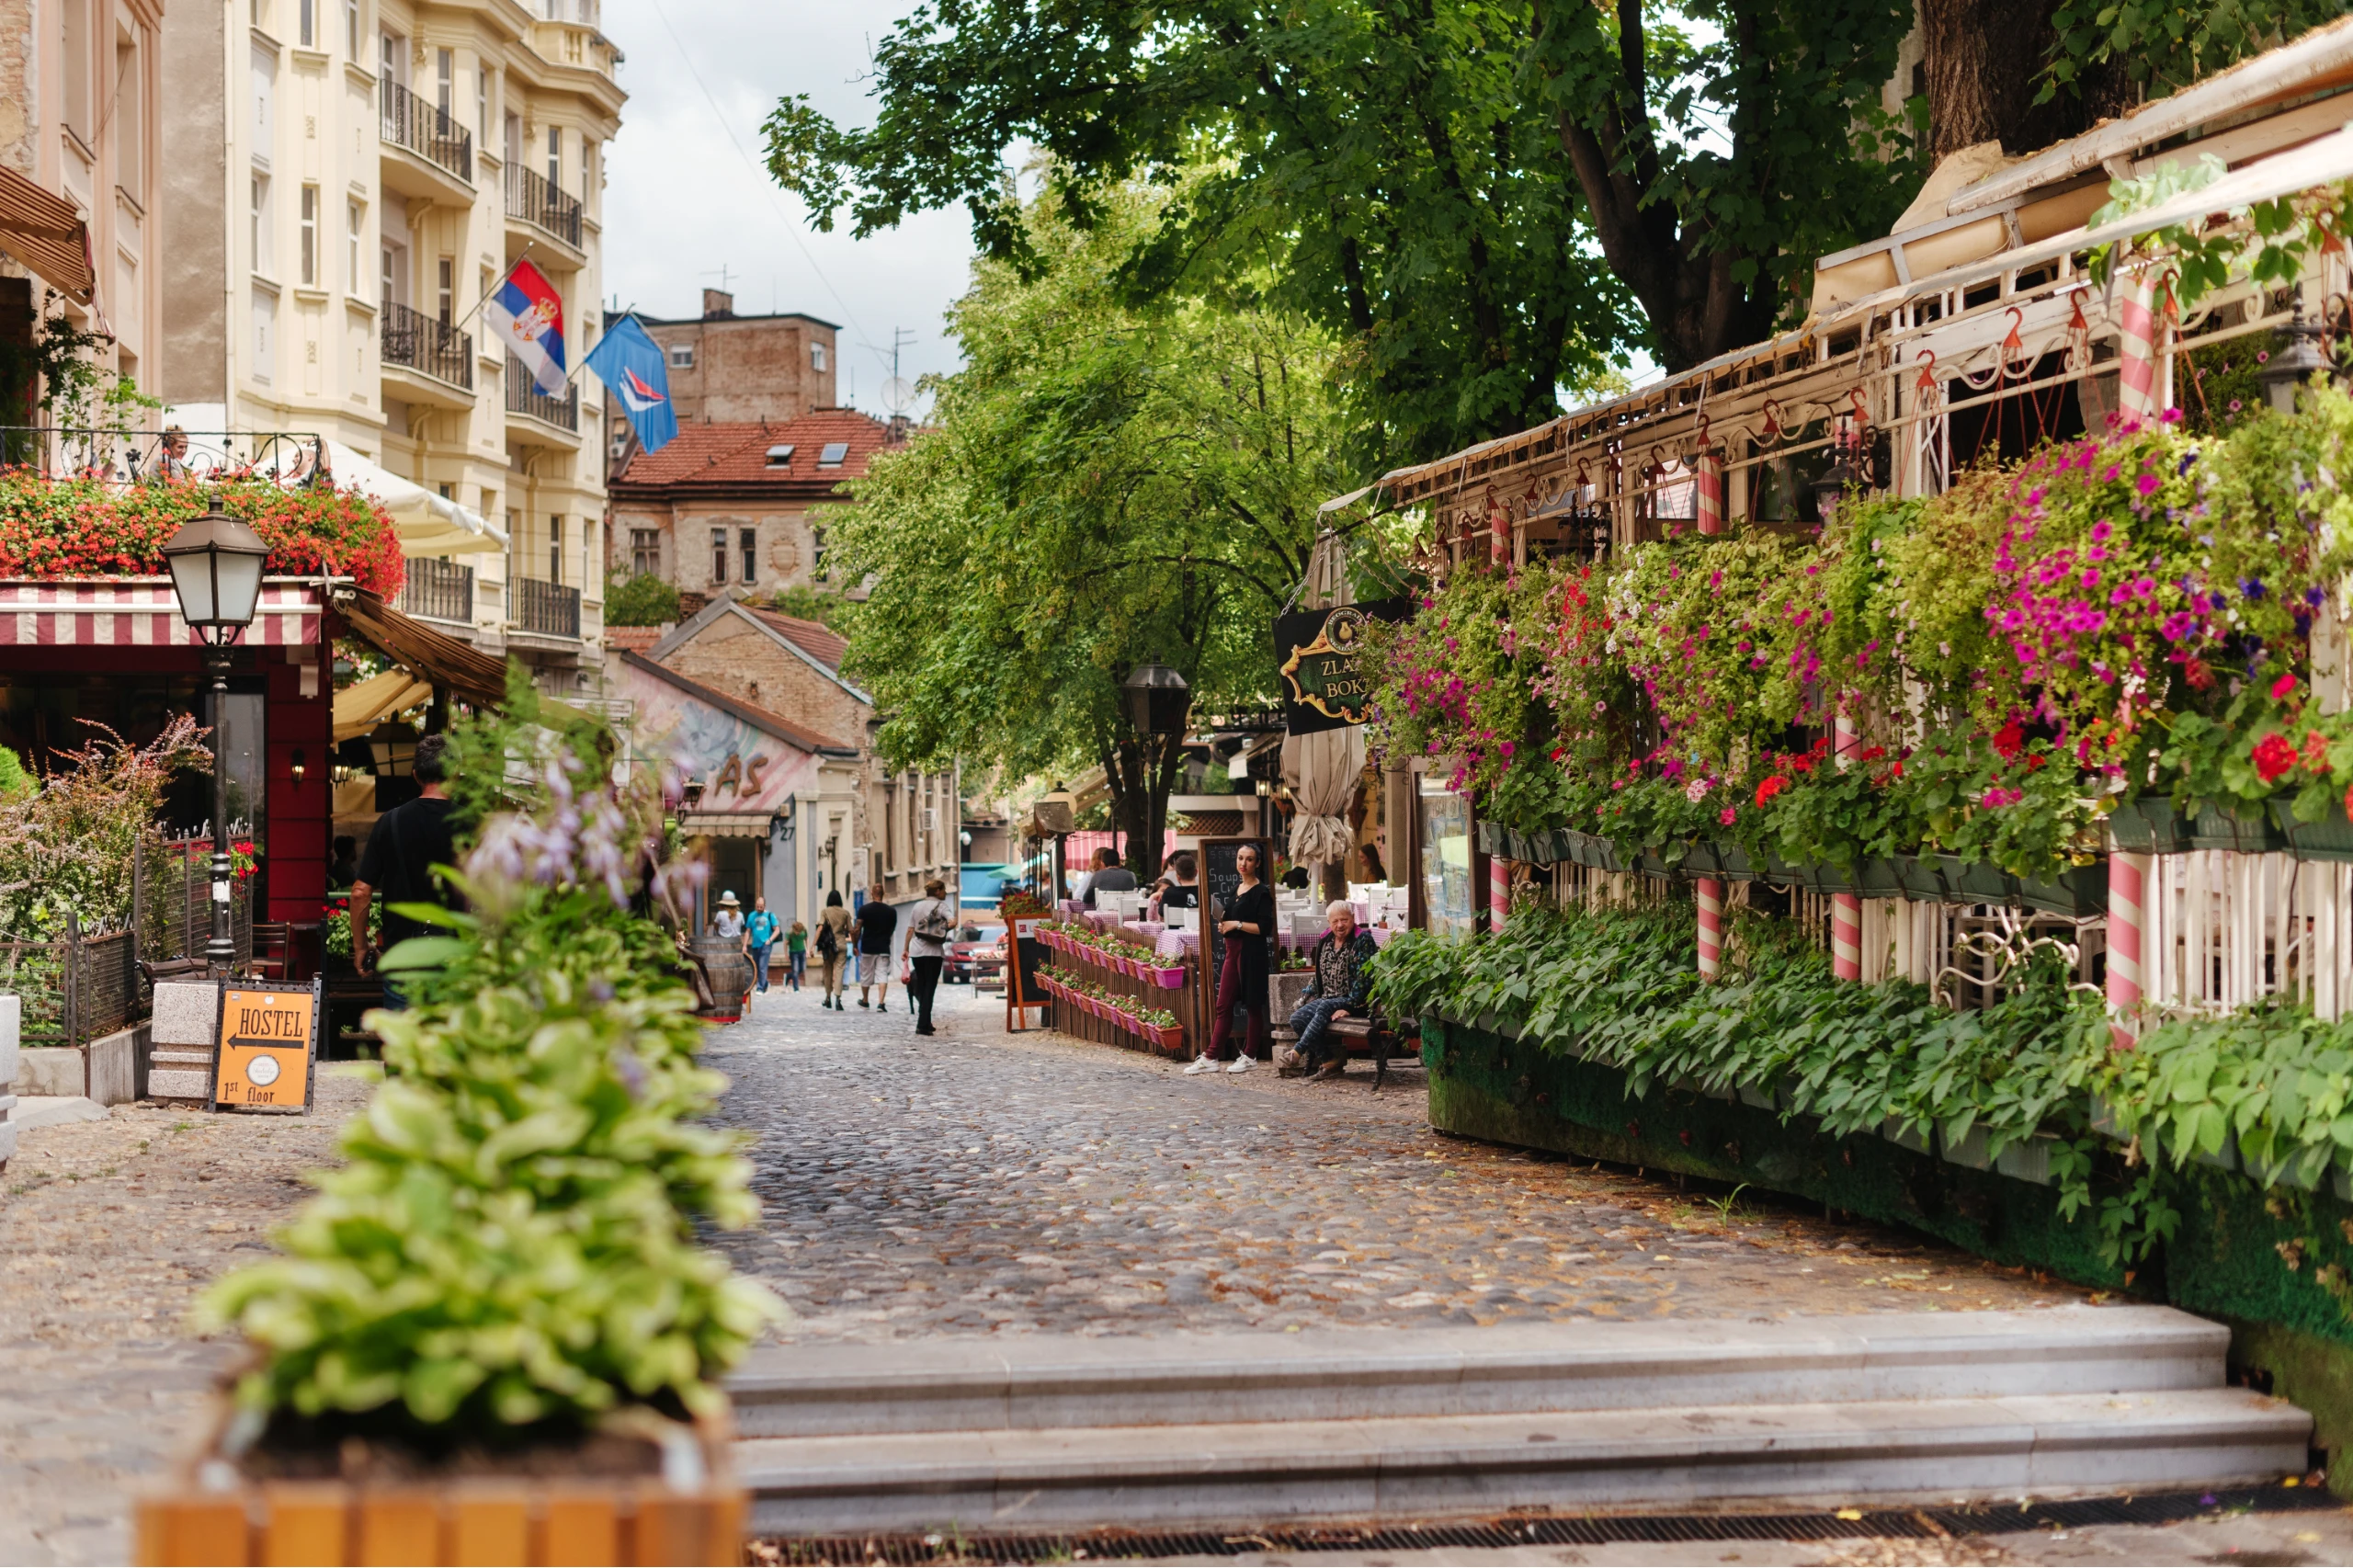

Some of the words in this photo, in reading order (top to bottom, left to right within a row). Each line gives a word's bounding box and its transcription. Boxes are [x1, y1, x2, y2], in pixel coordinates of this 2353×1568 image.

[1321, 657, 1356, 676] ZLA
[1324, 677, 1367, 699] BOK
[713, 754, 768, 798] AS
[780, 827, 795, 841] 27
[1209, 869, 1244, 885] Soups
[239, 1008, 302, 1037] HOSTEL
[246, 1087, 275, 1103] floor
